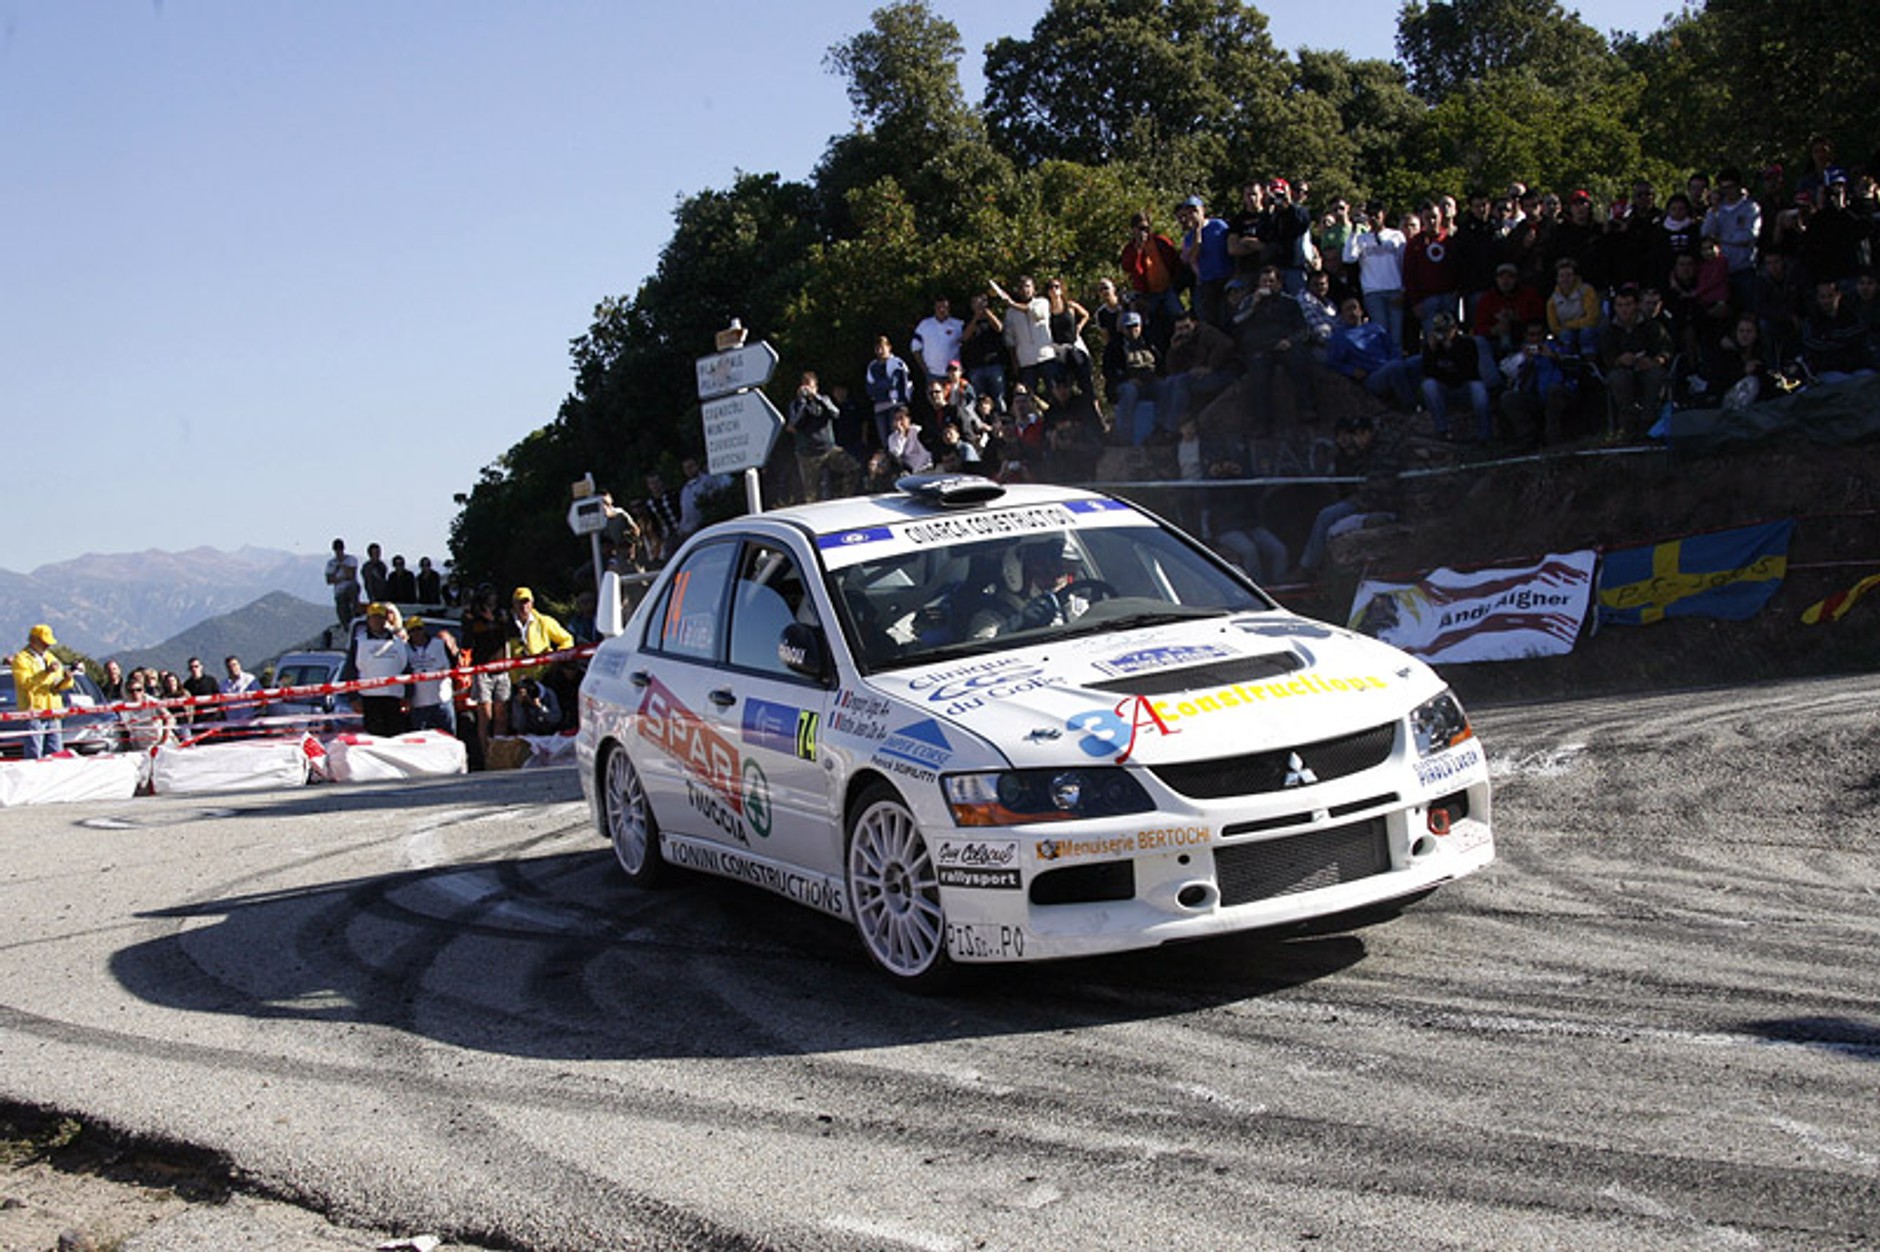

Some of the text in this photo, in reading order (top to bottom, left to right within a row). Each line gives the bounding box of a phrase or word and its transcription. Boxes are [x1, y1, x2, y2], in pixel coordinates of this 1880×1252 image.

[1439, 602, 1491, 628] Andi
[909, 657, 1023, 690] Clinique
[946, 697, 985, 715] du
[647, 691, 735, 797] SPAR
[798, 710, 819, 761] 74
[1060, 834, 1135, 859] Menuiserie
[670, 841, 843, 913] TONINI CONSTRUCTIONS
[940, 870, 1016, 887] rallysport
